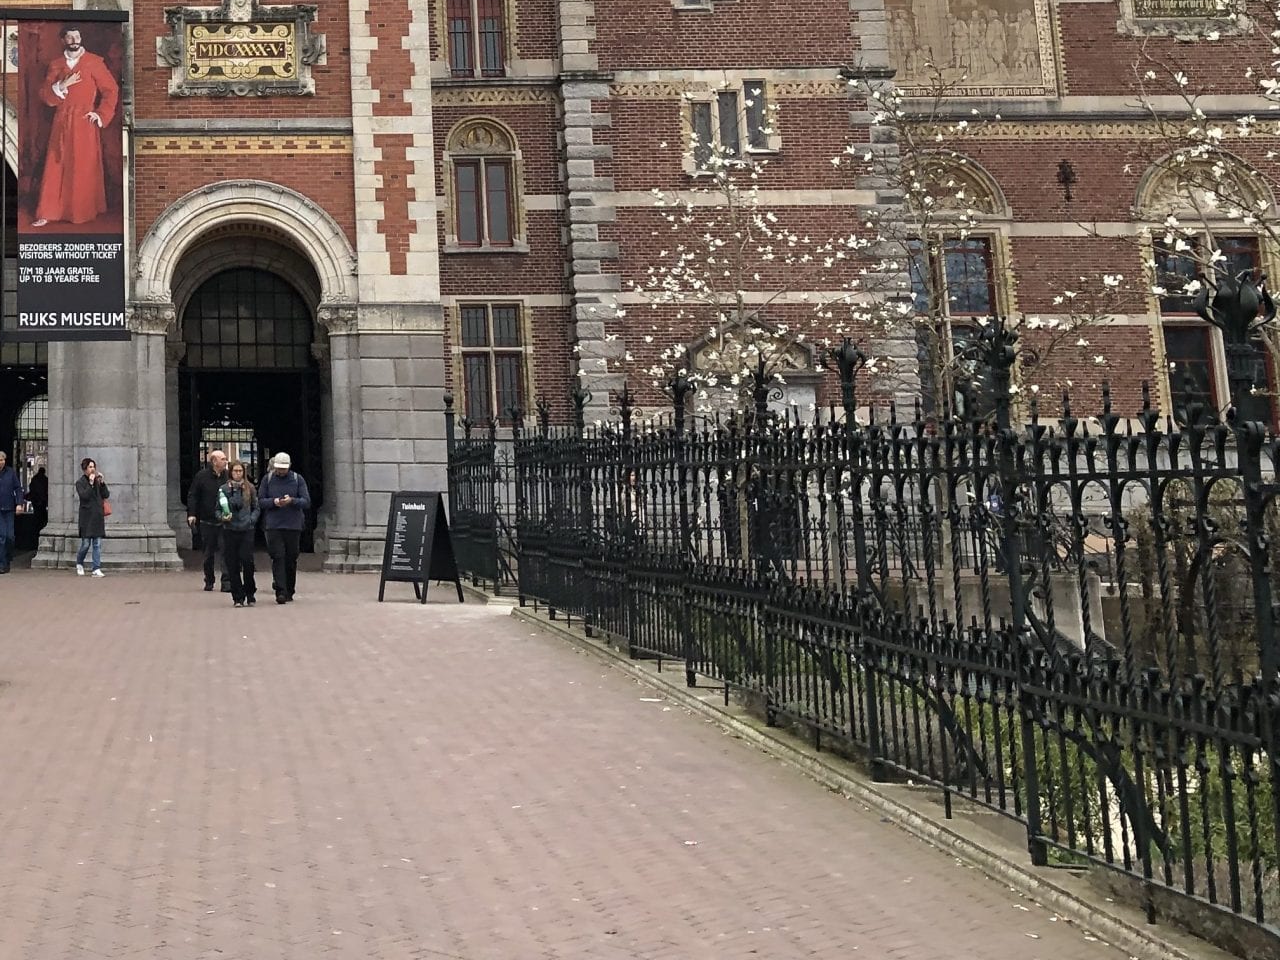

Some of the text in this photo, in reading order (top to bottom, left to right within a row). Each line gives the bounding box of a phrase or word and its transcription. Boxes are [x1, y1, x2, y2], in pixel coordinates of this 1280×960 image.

[19, 243, 122, 252] BEZOEKERS ZONDER TICKET
[19, 251, 118, 259] VISITORS WITHOUT TICKET
[19, 267, 94, 275] T/M 18 JAAR GRATIS
[19, 275, 100, 283] UP TO 18 YEARS FREE
[61, 312, 124, 326] MUSEUM
[401, 502, 426, 511] Tuinhuis
